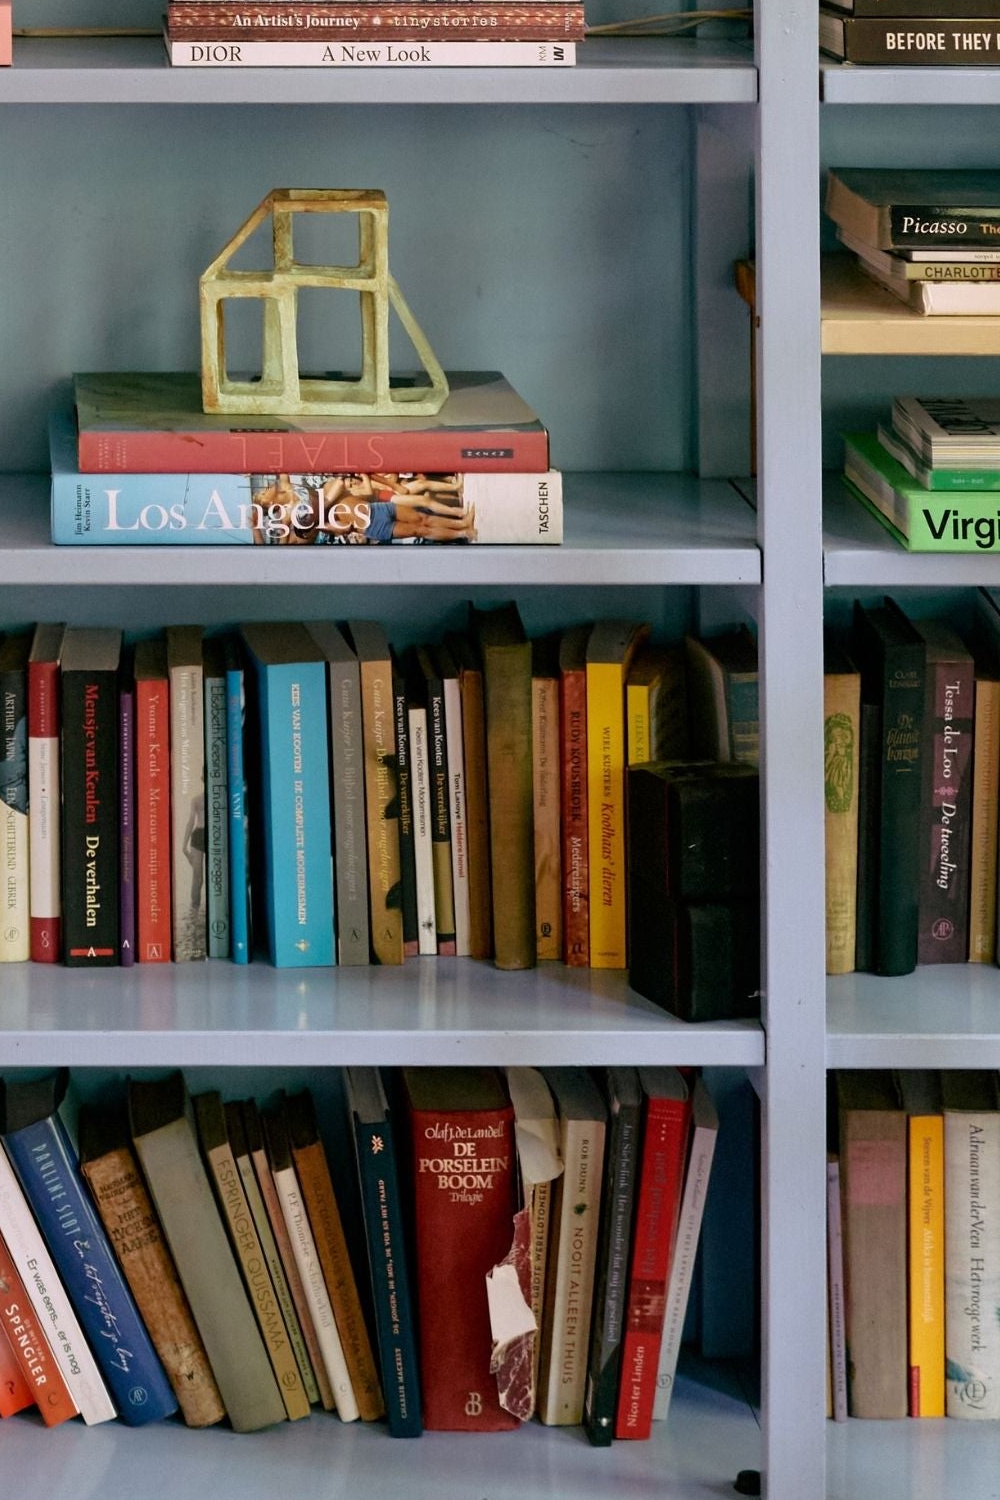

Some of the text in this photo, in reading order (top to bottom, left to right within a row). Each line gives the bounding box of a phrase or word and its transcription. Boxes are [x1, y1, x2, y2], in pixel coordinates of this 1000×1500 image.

[305, 14, 361, 30] Journey
[886, 32, 992, 51] BEFORE THEY
[190, 45, 432, 63] DIOR A New Look
[901, 216, 968, 235] Picasso
[102, 487, 372, 539] Los Angeles
[538, 482, 549, 534] TASCHEN
[922, 508, 1000, 549] Virgi
[210, 685, 226, 734] Elisabeth
[291, 683, 303, 773] KEES VAN KOOTEN
[942, 680, 960, 779] Tessa Loo
[85, 683, 100, 824] Mensje Keulen
[570, 710, 583, 822] RUDY KOUSBROEK
[147, 694, 162, 924] Yvonne Keuls Mevrouw mijn moeder
[601, 753, 616, 907] KUSTERS dieren
[936, 800, 957, 891] De tweeling
[85, 835, 100, 928] De verhalen
[418, 1155, 508, 1174] PORSELEIN
[453, 1142, 477, 1157] DE
[968, 1122, 985, 1166] Adriaan
[31, 1142, 82, 1240] PAULINE SLOT
[437, 1174, 494, 1189] BOOM
[562, 1162, 589, 1386] DUNN NOOIT ALLEEN THUIS
[4, 1302, 48, 1388] SPENGLER
[632, 1344, 646, 1384] Linden
